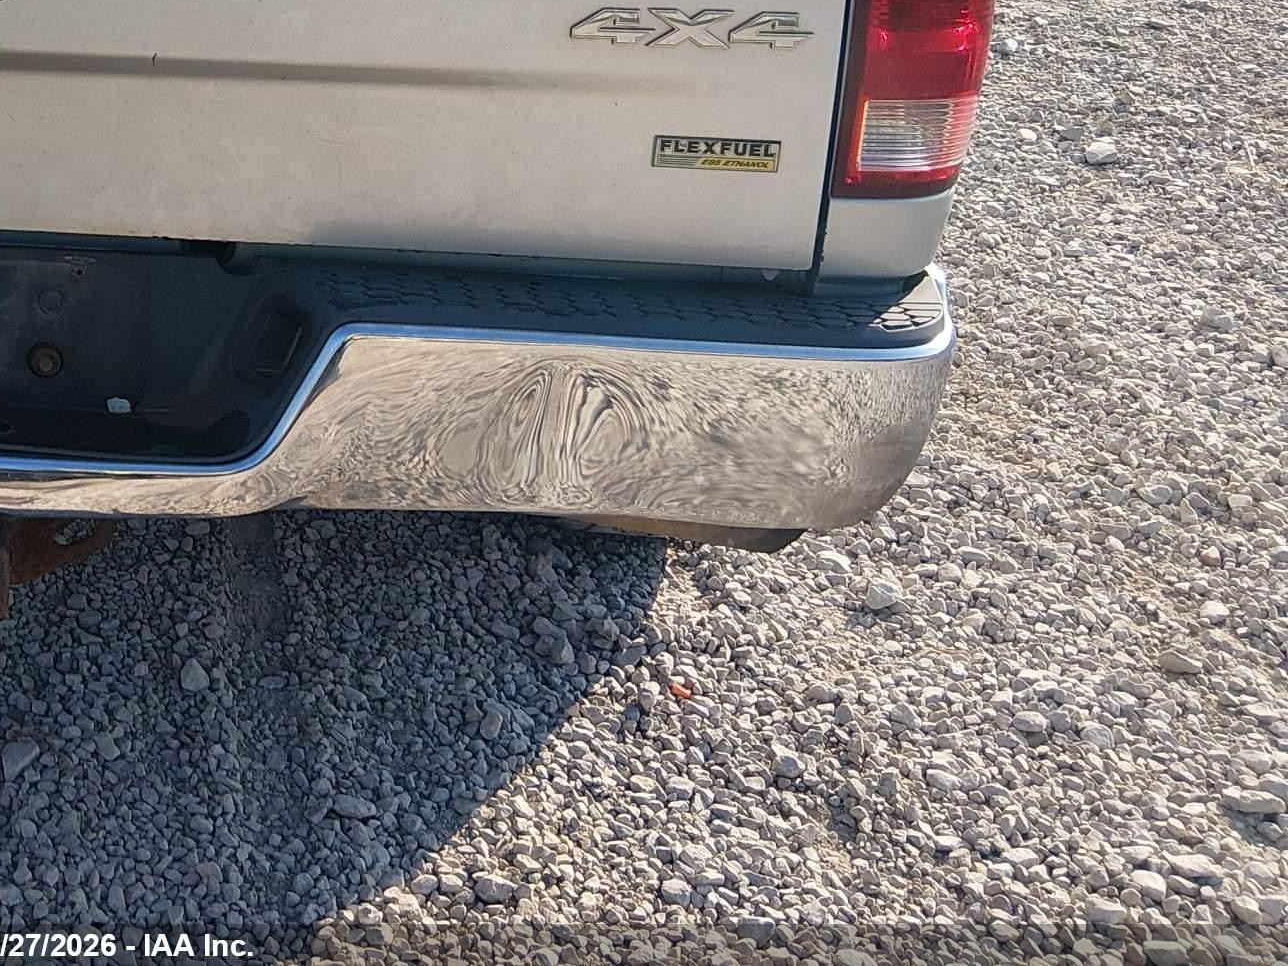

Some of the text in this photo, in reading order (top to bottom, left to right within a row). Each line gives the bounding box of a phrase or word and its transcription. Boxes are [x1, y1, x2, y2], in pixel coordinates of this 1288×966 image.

[569, 7, 815, 50] 4X4
[659, 138, 776, 157] FLEXFUEL
[700, 158, 770, 168] E85 ETHANOL
